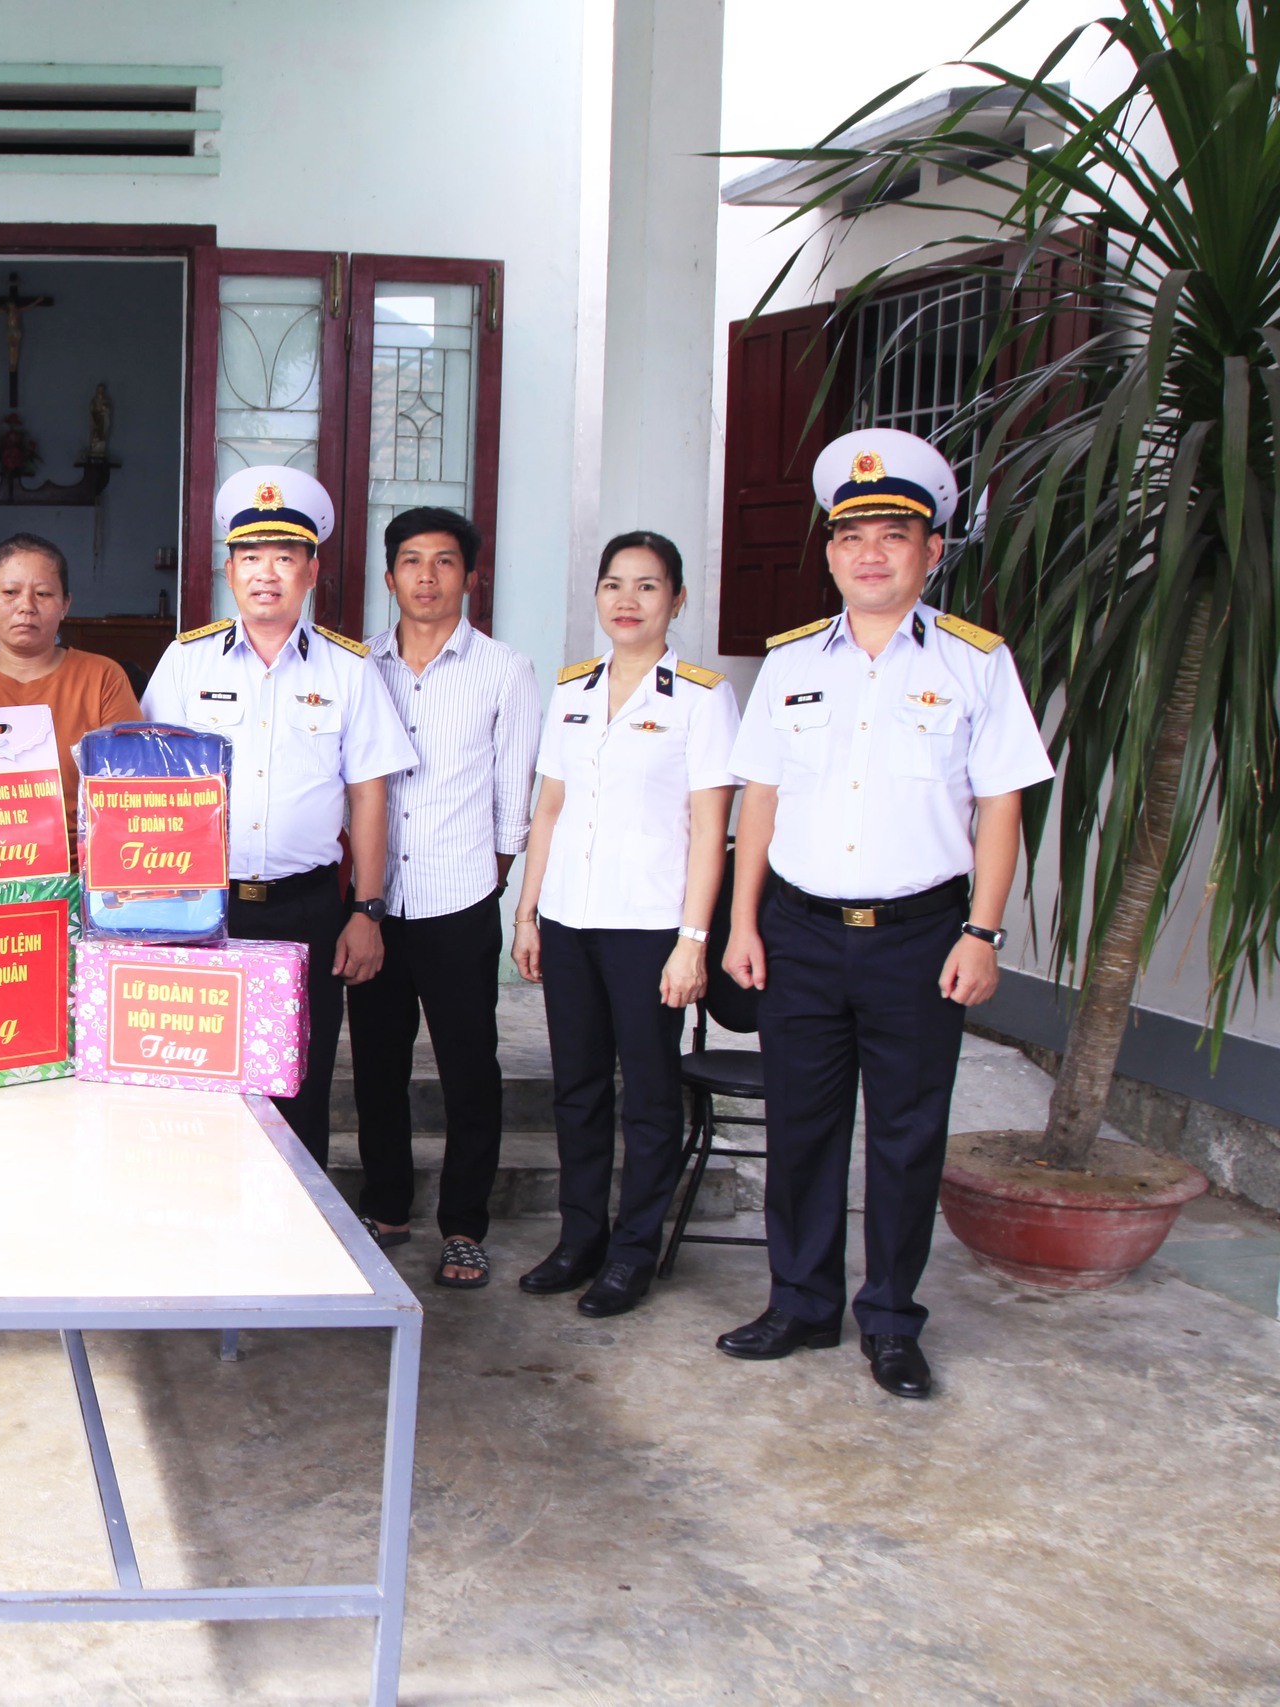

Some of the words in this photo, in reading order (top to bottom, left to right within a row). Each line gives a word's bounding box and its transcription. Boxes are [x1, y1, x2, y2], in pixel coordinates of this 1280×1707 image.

[12, 786, 17, 799] 4
[18, 779, 33, 798] HẢI
[34, 779, 57, 797] QUÂN
[92, 790, 105, 811] BỘ
[106, 792, 119, 808] TƯ
[119, 791, 142, 812] LỆNH
[144, 791, 167, 808] VÙNG
[169, 793, 175, 807] 4
[176, 788, 192, 807] HẢI
[193, 788, 218, 808] QUÂN
[12, 809, 28, 824] 162
[128, 816, 140, 833] LỮ
[141, 814, 165, 832] ĐOÀN
[167, 817, 184, 832] 162
[120, 841, 193, 874] Tặng
[11, 931, 42, 957] LỆNH
[123, 980, 145, 1000] LỮ
[147, 981, 194, 1004] ĐOÀN
[199, 987, 230, 1007] 162
[127, 1008, 156, 1032] HỘI
[160, 1013, 194, 1035] PHỤ
[199, 1013, 224, 1034] NỮ
[139, 1034, 209, 1067] Tặng
